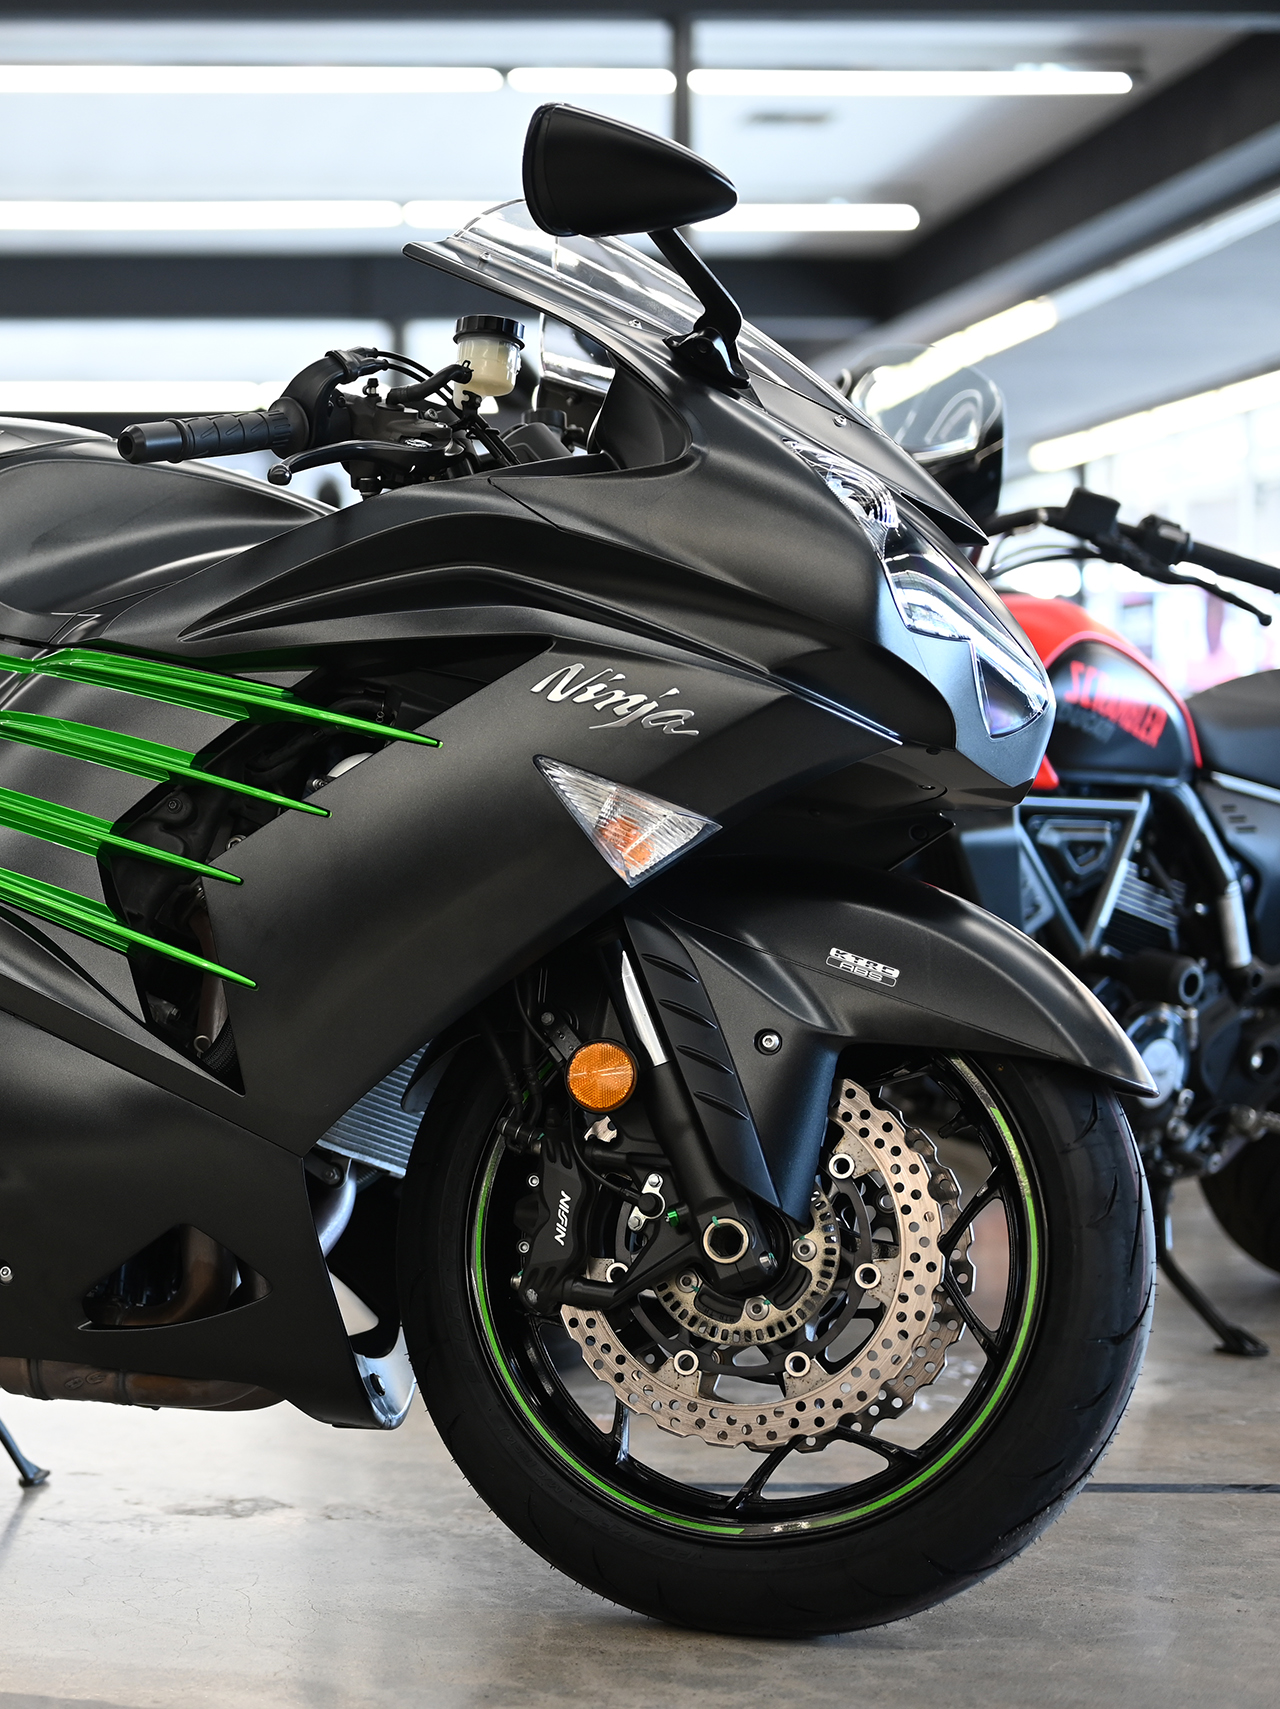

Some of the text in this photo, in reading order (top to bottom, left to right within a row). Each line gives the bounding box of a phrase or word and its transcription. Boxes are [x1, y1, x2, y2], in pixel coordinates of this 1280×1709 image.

[530, 662, 699, 737] Ninja
[832, 948, 897, 977] KTRC
[840, 961, 883, 983] ABS
